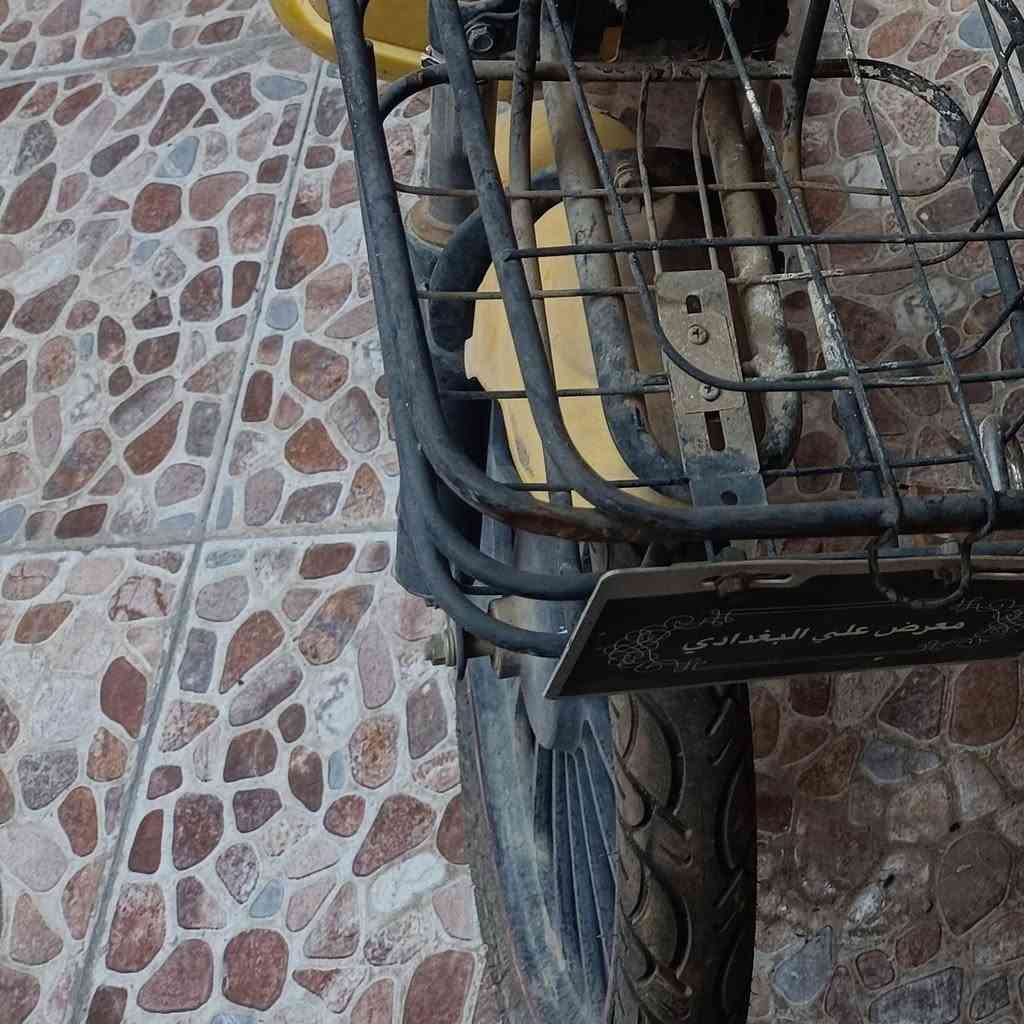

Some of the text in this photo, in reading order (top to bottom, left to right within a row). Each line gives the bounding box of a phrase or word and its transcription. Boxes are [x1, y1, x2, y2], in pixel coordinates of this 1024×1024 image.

[682, 621, 966, 654] معرض علي البغدادي
